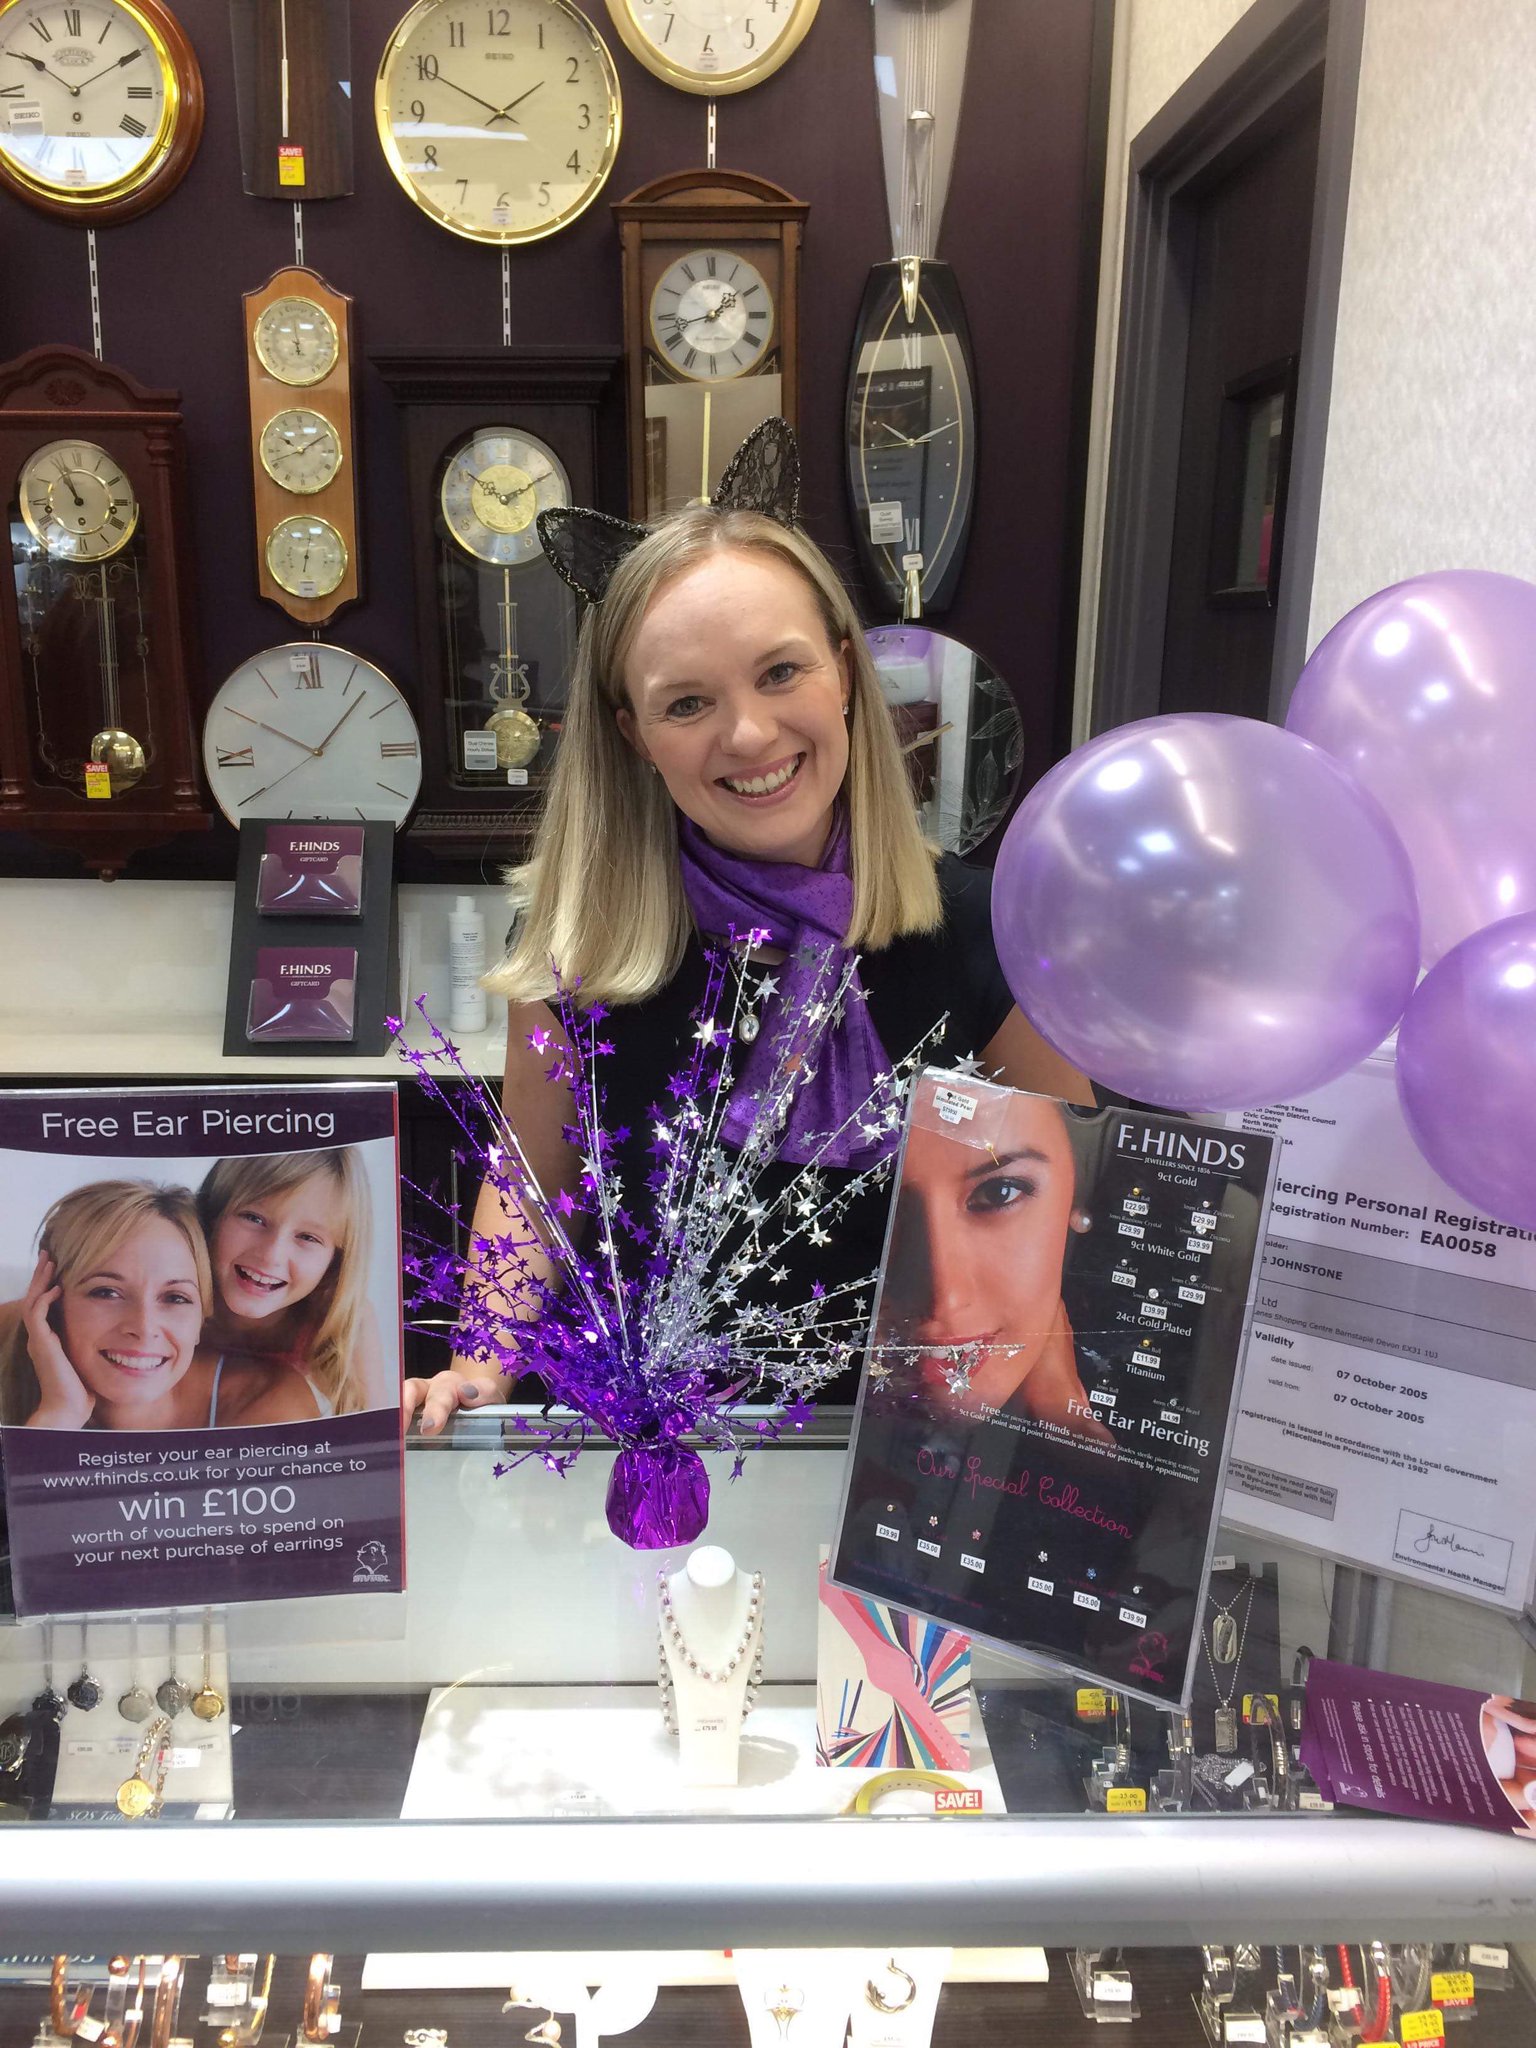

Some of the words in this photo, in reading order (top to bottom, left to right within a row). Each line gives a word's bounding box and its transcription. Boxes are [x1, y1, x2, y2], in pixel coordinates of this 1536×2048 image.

[488, 9, 511, 36] 12
[664, 13, 675, 43] 7
[744, 18, 754, 49] 5
[448, 22, 465, 48] 11
[537, 24, 544, 49] 1
[416, 54, 438, 80] 10
[566, 57, 579, 84] 2
[14, 112, 40, 120] SEIKO
[411, 100, 425, 126] 9
[578, 104, 590, 130] 3
[424, 145, 438, 171] 8
[566, 150, 581, 175] 4
[455, 179, 468, 204] 7
[538, 182, 550, 207] 5
[901, 333, 922, 370] XII
[904, 518, 920, 552] VI
[86, 764, 108, 772] SAVE!
[290, 841, 340, 852] F.HINDS
[280, 964, 332, 976] F.HINDS
[1242, 1118, 1260, 1126] North
[1260, 1114, 1282, 1122] Centre
[1264, 1108, 1284, 1116] Devon
[1286, 1112, 1310, 1121] District
[1312, 1116, 1336, 1126] Council
[1290, 1106, 1308, 1114] Team
[42, 1112, 119, 1138] Free
[132, 1110, 189, 1136] Ear
[202, 1108, 336, 1138] Piercing
[1118, 1124, 1246, 1170] F.HINDS
[1144, 1156, 1176, 1168] JEWELLERS
[1177, 1162, 1195, 1172] SINCE
[1157, 1172, 1172, 1182] 9ct
[1174, 1174, 1198, 1187] Gold
[1124, 1202, 1146, 1212] £22.99
[1276, 1178, 1338, 1205] iercing
[1344, 1192, 1428, 1220] Personal
[1120, 1224, 1142, 1236] £29.99
[1192, 1214, 1215, 1226] £29.99
[1188, 1239, 1210, 1250] £39.99
[1350, 1218, 1410, 1239] Number:
[1420, 1230, 1497, 1258] EA0058
[1130, 1240, 1144, 1251] 9ct
[1148, 1244, 1176, 1258] White
[1178, 1250, 1200, 1263] Gold
[1114, 1274, 1134, 1286] £22.99
[1270, 1256, 1343, 1280] JOHNSTONE
[1182, 1290, 1204, 1301] £29.99
[1262, 1296, 1278, 1308] Ltd
[1144, 1306, 1165, 1316] £39.99
[1116, 1311, 1135, 1324] 24ct
[1138, 1316, 1160, 1330] Gold
[1162, 1322, 1192, 1336] Plated
[1274, 1314, 1307, 1328] Shopping
[1309, 1322, 1333, 1334] Centre
[1335, 1328, 1374, 1344] Barnstaple
[1376, 1338, 1400, 1350] Devon
[1402, 1344, 1421, 1354] EX31
[1255, 1330, 1294, 1348] Validity
[1136, 1354, 1158, 1365] £11.99
[1270, 1356, 1287, 1364] date
[1288, 1360, 1314, 1372] issued:
[1126, 1364, 1166, 1382] Titanium
[1268, 1378, 1283, 1386] valid
[1284, 1382, 1300, 1391] from:
[1336, 1370, 1350, 1380] 07
[1353, 1374, 1396, 1392] October
[1400, 1386, 1428, 1400] 2005
[1092, 1393, 1113, 1404] £12.99
[1334, 1394, 1347, 1403] 07
[1350, 1398, 1394, 1416] October
[1396, 1410, 1425, 1424] 2005
[980, 1402, 1000, 1416] Free
[1038, 1420, 1070, 1436] F.Hinds
[1085, 1436, 1110, 1448] purchase
[1155, 1456, 1176, 1468] piercing
[1178, 1463, 1200, 1474] earrings
[1068, 1398, 1102, 1417] Free
[1109, 1410, 1135, 1430] Ear
[1140, 1419, 1210, 1457] Piercing
[78, 1451, 152, 1468] Register
[159, 1447, 199, 1464] your
[204, 1446, 232, 1460] ear
[239, 1442, 308, 1461] piercing
[314, 1441, 331, 1454] at
[960, 1408, 970, 1416] 9ct
[970, 1412, 986, 1421] Gold
[991, 1418, 1008, 1428] point
[1008, 1422, 1020, 1431] and
[1026, 1428, 1044, 1438] point
[1044, 1432, 1076, 1448] Diamonds
[1078, 1442, 1106, 1456] available
[1106, 1450, 1117, 1459] for
[1118, 1454, 1144, 1469] piercing
[1146, 1462, 1154, 1471] by
[1155, 1465, 1199, 1484] appointment
[1241, 1408, 1286, 1426] registration
[1298, 1424, 1322, 1436] issued
[1325, 1432, 1332, 1440] in
[1334, 1436, 1380, 1453] accordance
[1382, 1448, 1400, 1458] with
[1403, 1454, 1417, 1463] the
[1420, 1458, 1442, 1470] Local
[1444, 1465, 1498, 1486] Government
[1282, 1428, 1341, 1450] (Miscellaneous
[1343, 1445, 1388, 1464] Provisions)
[1391, 1459, 1404, 1468] Act
[1408, 1464, 1429, 1474] 1982
[43, 1466, 200, 1488] www.fhinds.co.uk
[206, 1465, 232, 1479] for
[237, 1464, 274, 1481] your
[281, 1459, 344, 1476] chance
[349, 1458, 366, 1472] to
[118, 1492, 185, 1521] win
[202, 1486, 296, 1518] £100
[917, 1448, 956, 1480] Our
[964, 1456, 1030, 1500] Special
[1038, 1475, 1133, 1540] Collection
[72, 1528, 125, 1544] worth
[130, 1526, 147, 1540] of
[154, 1523, 234, 1539] vouchers
[240, 1522, 258, 1535] to
[263, 1518, 316, 1536] spend
[322, 1517, 344, 1530] on
[880, 1526, 898, 1540] £39.99
[74, 1550, 114, 1566] your
[122, 1546, 160, 1561] next
[166, 1542, 244, 1560] purchase
[251, 1540, 268, 1554] of
[274, 1536, 344, 1553] earrings
[919, 1540, 938, 1554] £35.00
[962, 1556, 983, 1570] £35.00
[1395, 1552, 1446, 1573] Environmental
[1448, 1569, 1471, 1581] Health
[1472, 1576, 1506, 1592] Manager
[1031, 1580, 1052, 1592] £35.00
[1077, 1594, 1098, 1608] £35.00
[1122, 1610, 1144, 1624] £39.99
[1352, 1700, 1364, 1722] Please
[1357, 1722, 1368, 1735] ask
[1363, 1744, 1374, 1762] store
[1368, 1763, 1378, 1774] for
[1372, 1774, 1386, 1799] details
[936, 1792, 979, 1808] SAVE!
